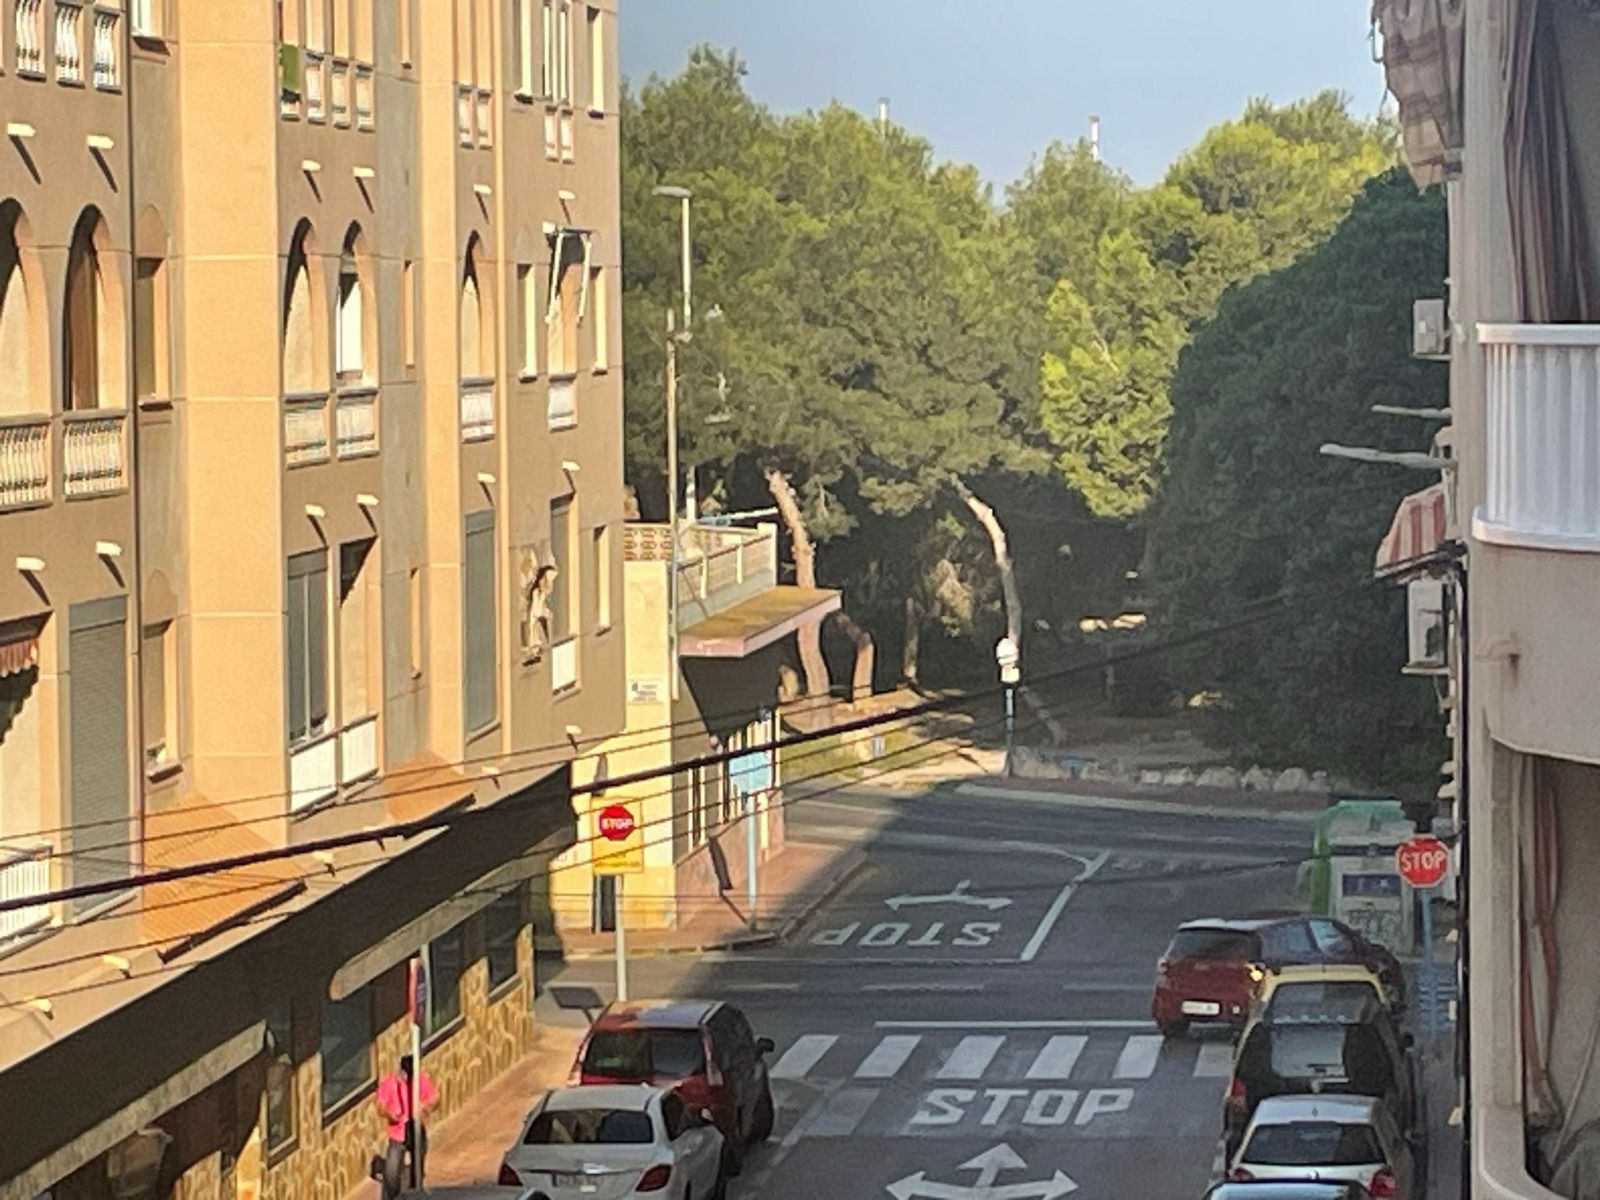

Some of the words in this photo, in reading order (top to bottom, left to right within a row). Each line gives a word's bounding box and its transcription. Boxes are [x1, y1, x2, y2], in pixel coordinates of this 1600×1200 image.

[601, 817, 633, 831] STOP
[1401, 850, 1446, 873] STOP
[809, 922, 1002, 946] STOP
[910, 1088, 1135, 1126] STOP
